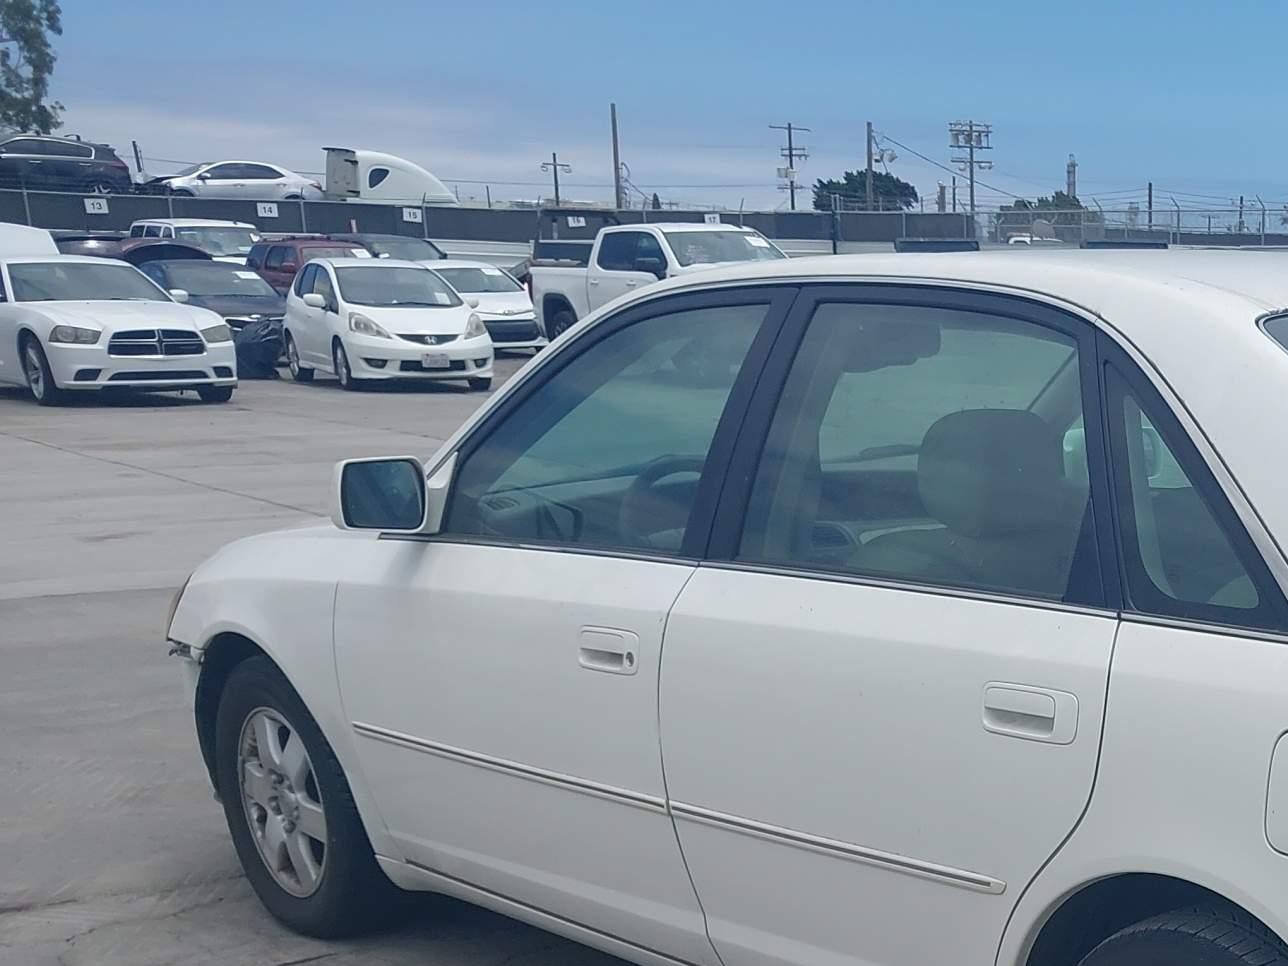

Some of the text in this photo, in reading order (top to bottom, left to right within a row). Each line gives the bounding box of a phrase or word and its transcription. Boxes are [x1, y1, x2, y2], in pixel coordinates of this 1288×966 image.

[91, 202, 102, 210] 13
[263, 206, 272, 214] 14
[408, 211, 417, 219] 15
